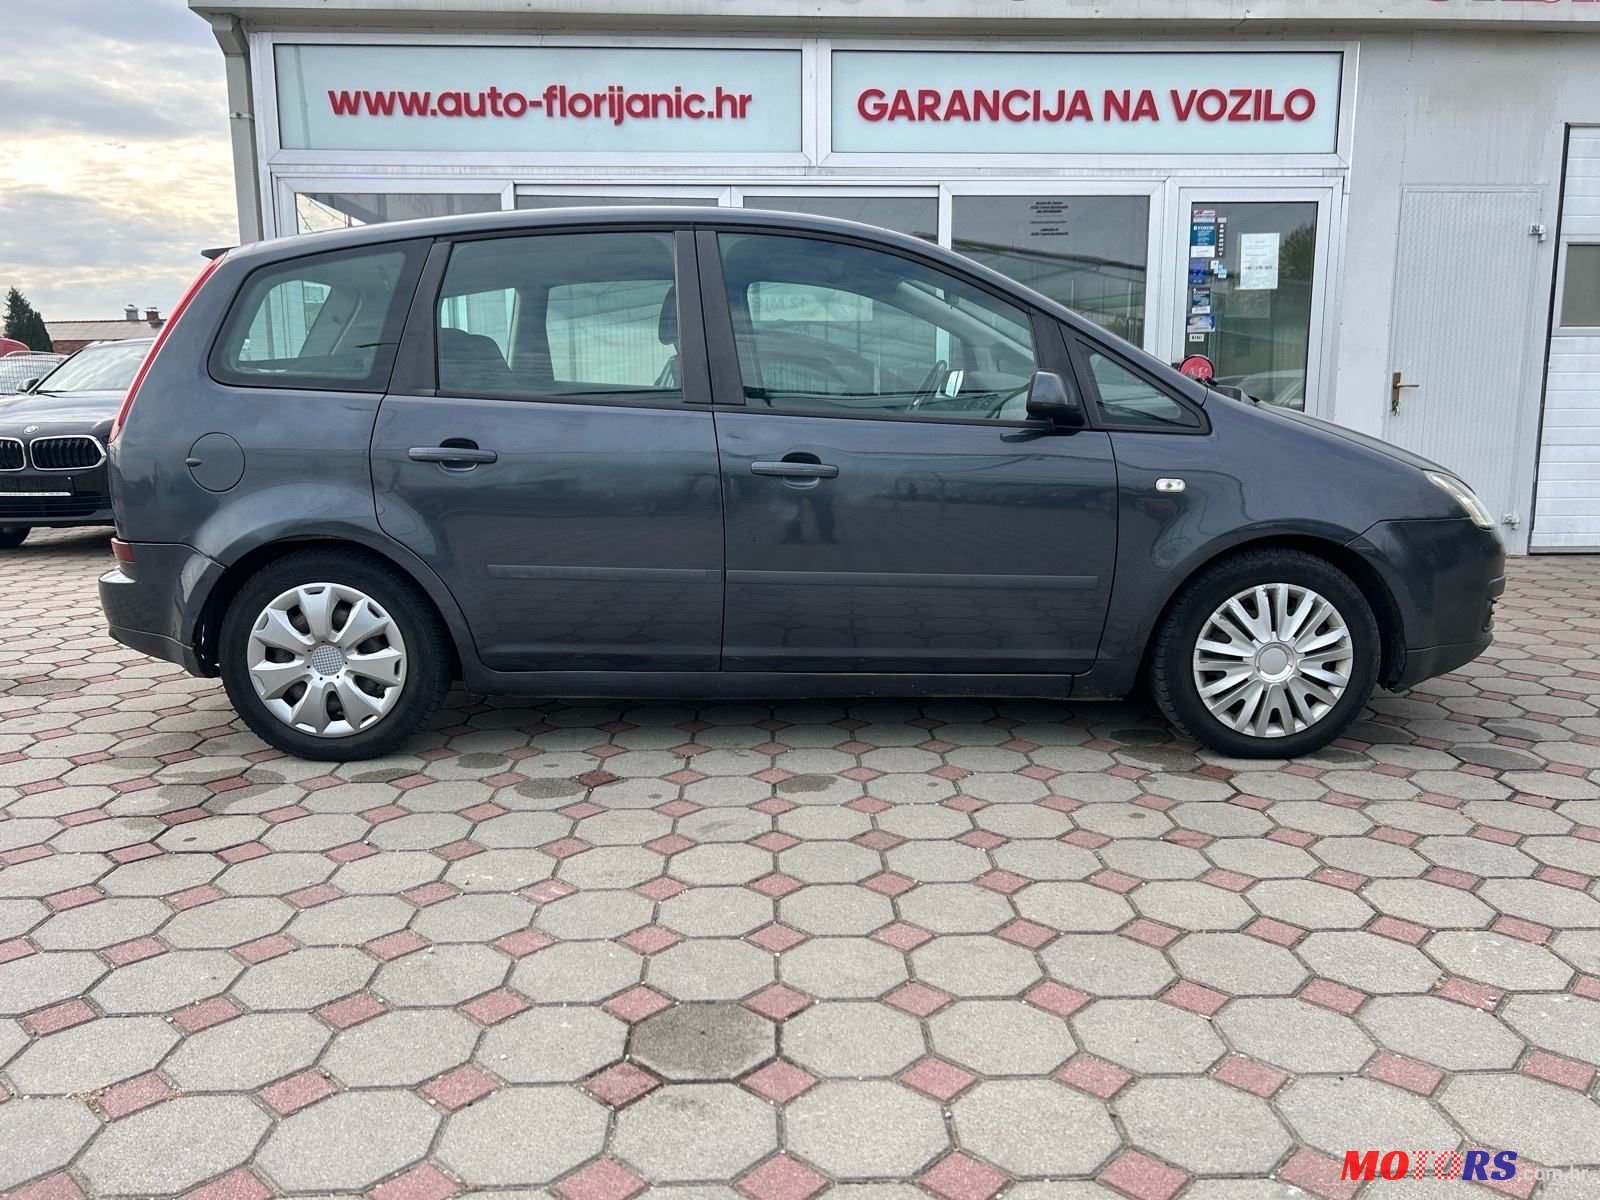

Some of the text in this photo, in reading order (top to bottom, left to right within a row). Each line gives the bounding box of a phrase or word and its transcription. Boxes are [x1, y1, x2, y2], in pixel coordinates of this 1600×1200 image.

[328, 86, 753, 126] www.auto-florijanic.hr
[857, 88, 1316, 122] GARANCIJA NA VOZILO
